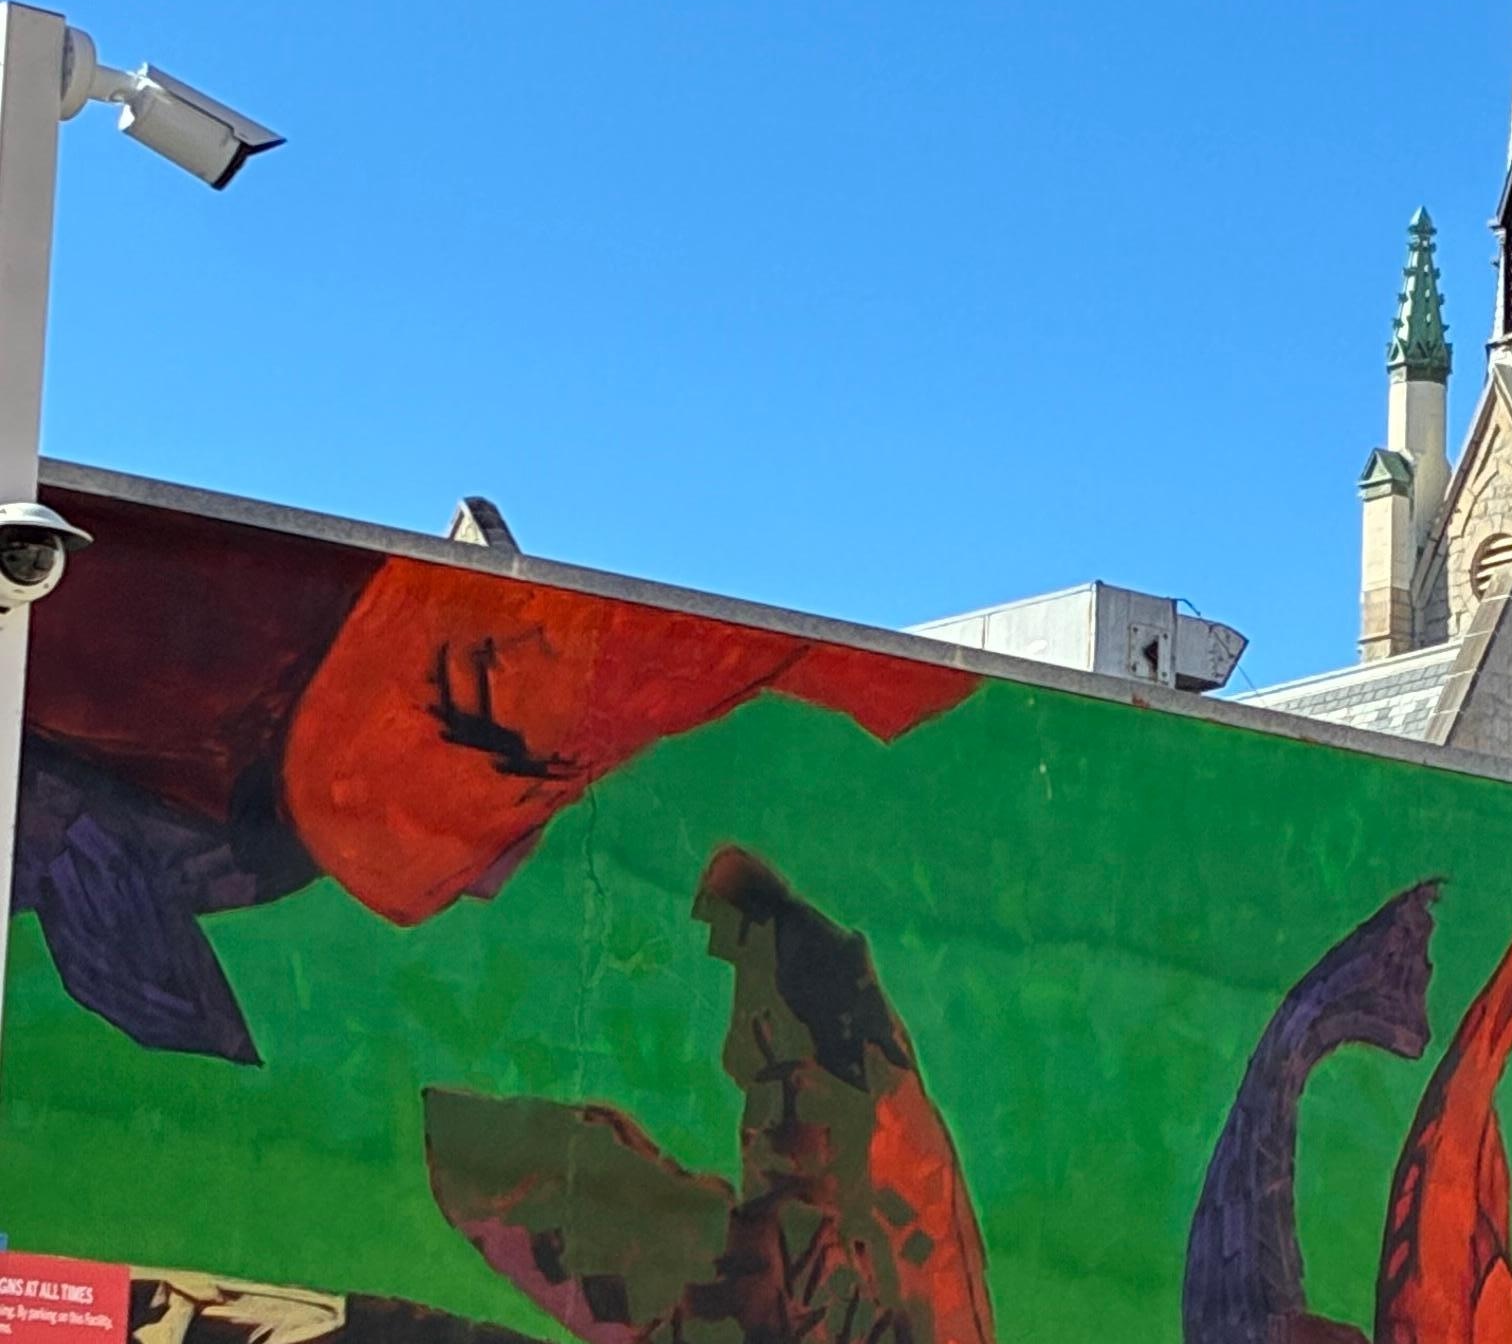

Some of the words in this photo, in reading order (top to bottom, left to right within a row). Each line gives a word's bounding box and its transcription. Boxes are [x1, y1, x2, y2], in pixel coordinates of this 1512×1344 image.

[24, 1280, 39, 1297] AT
[38, 1281, 60, 1301] ALL
[61, 1283, 94, 1305] TIMES
